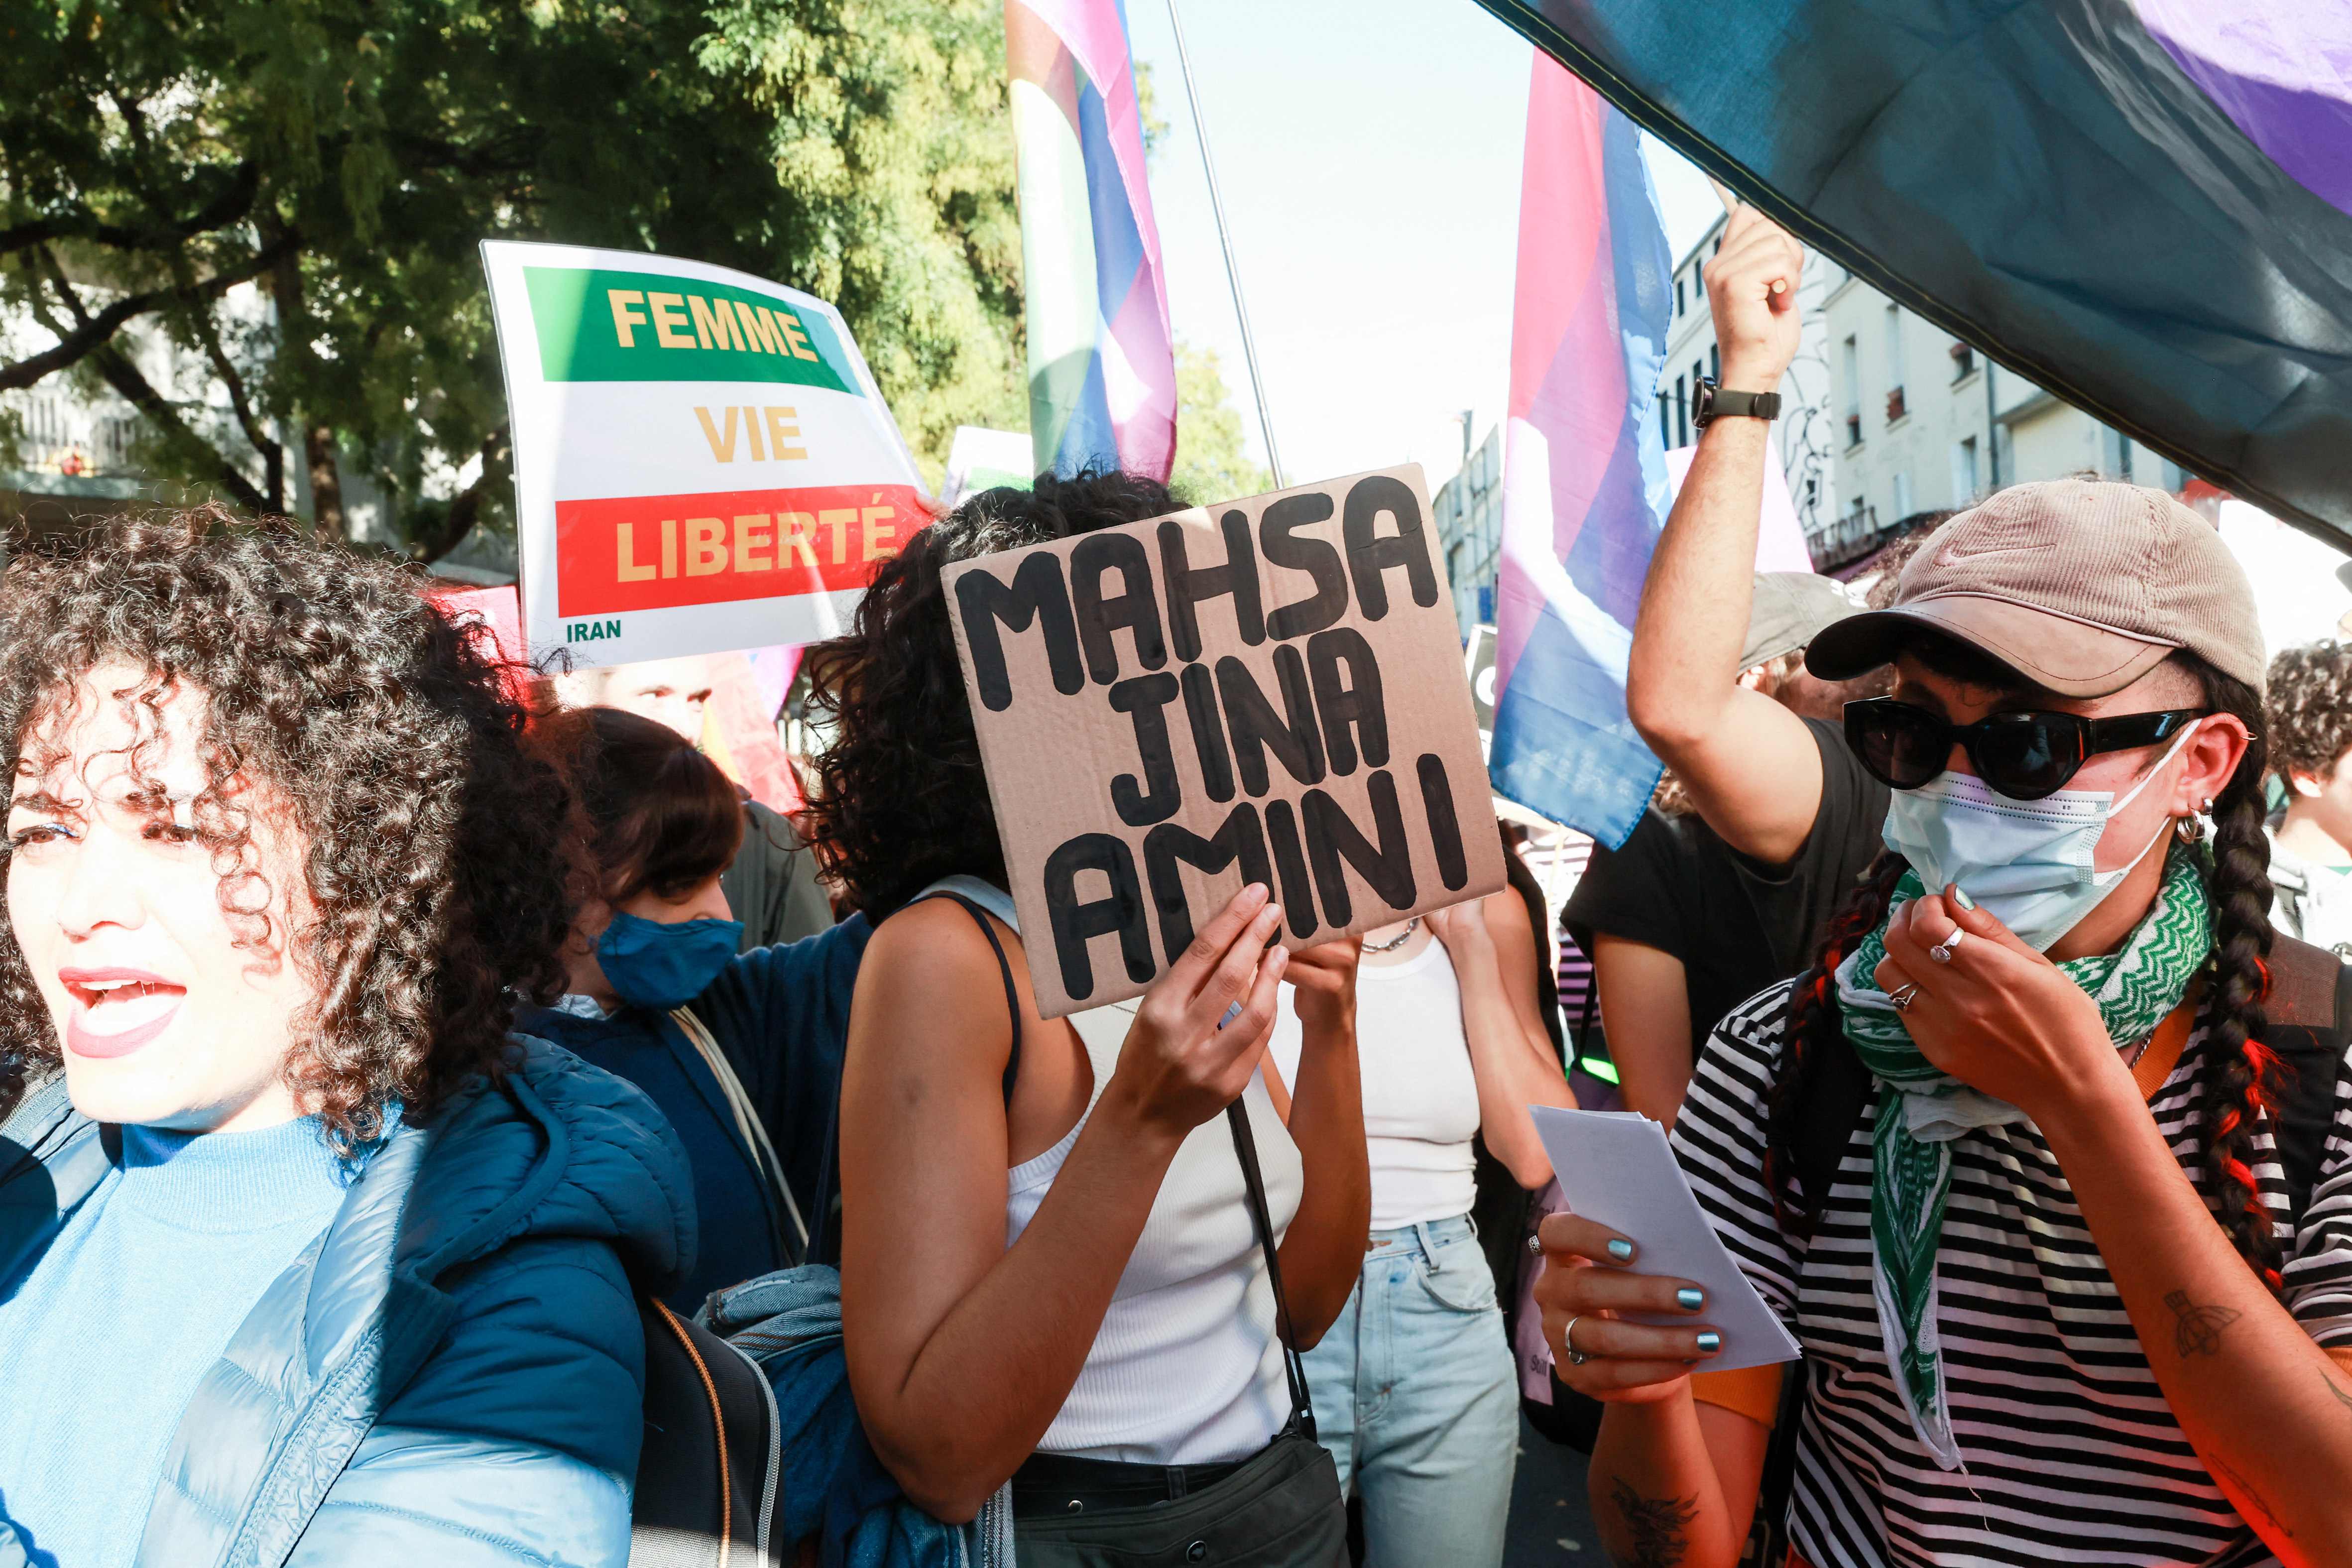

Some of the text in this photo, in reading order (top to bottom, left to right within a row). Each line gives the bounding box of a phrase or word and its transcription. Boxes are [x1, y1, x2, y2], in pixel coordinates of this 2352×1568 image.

[607, 289, 819, 362] FEMME
[693, 406, 808, 464] VIE
[616, 492, 897, 583] LIBERTÉ
[566, 619, 622, 643] IRAN
[954, 476, 1438, 712] MAHSA
[1108, 627, 1390, 827] JINA
[1044, 753, 1468, 1000] AMINI
